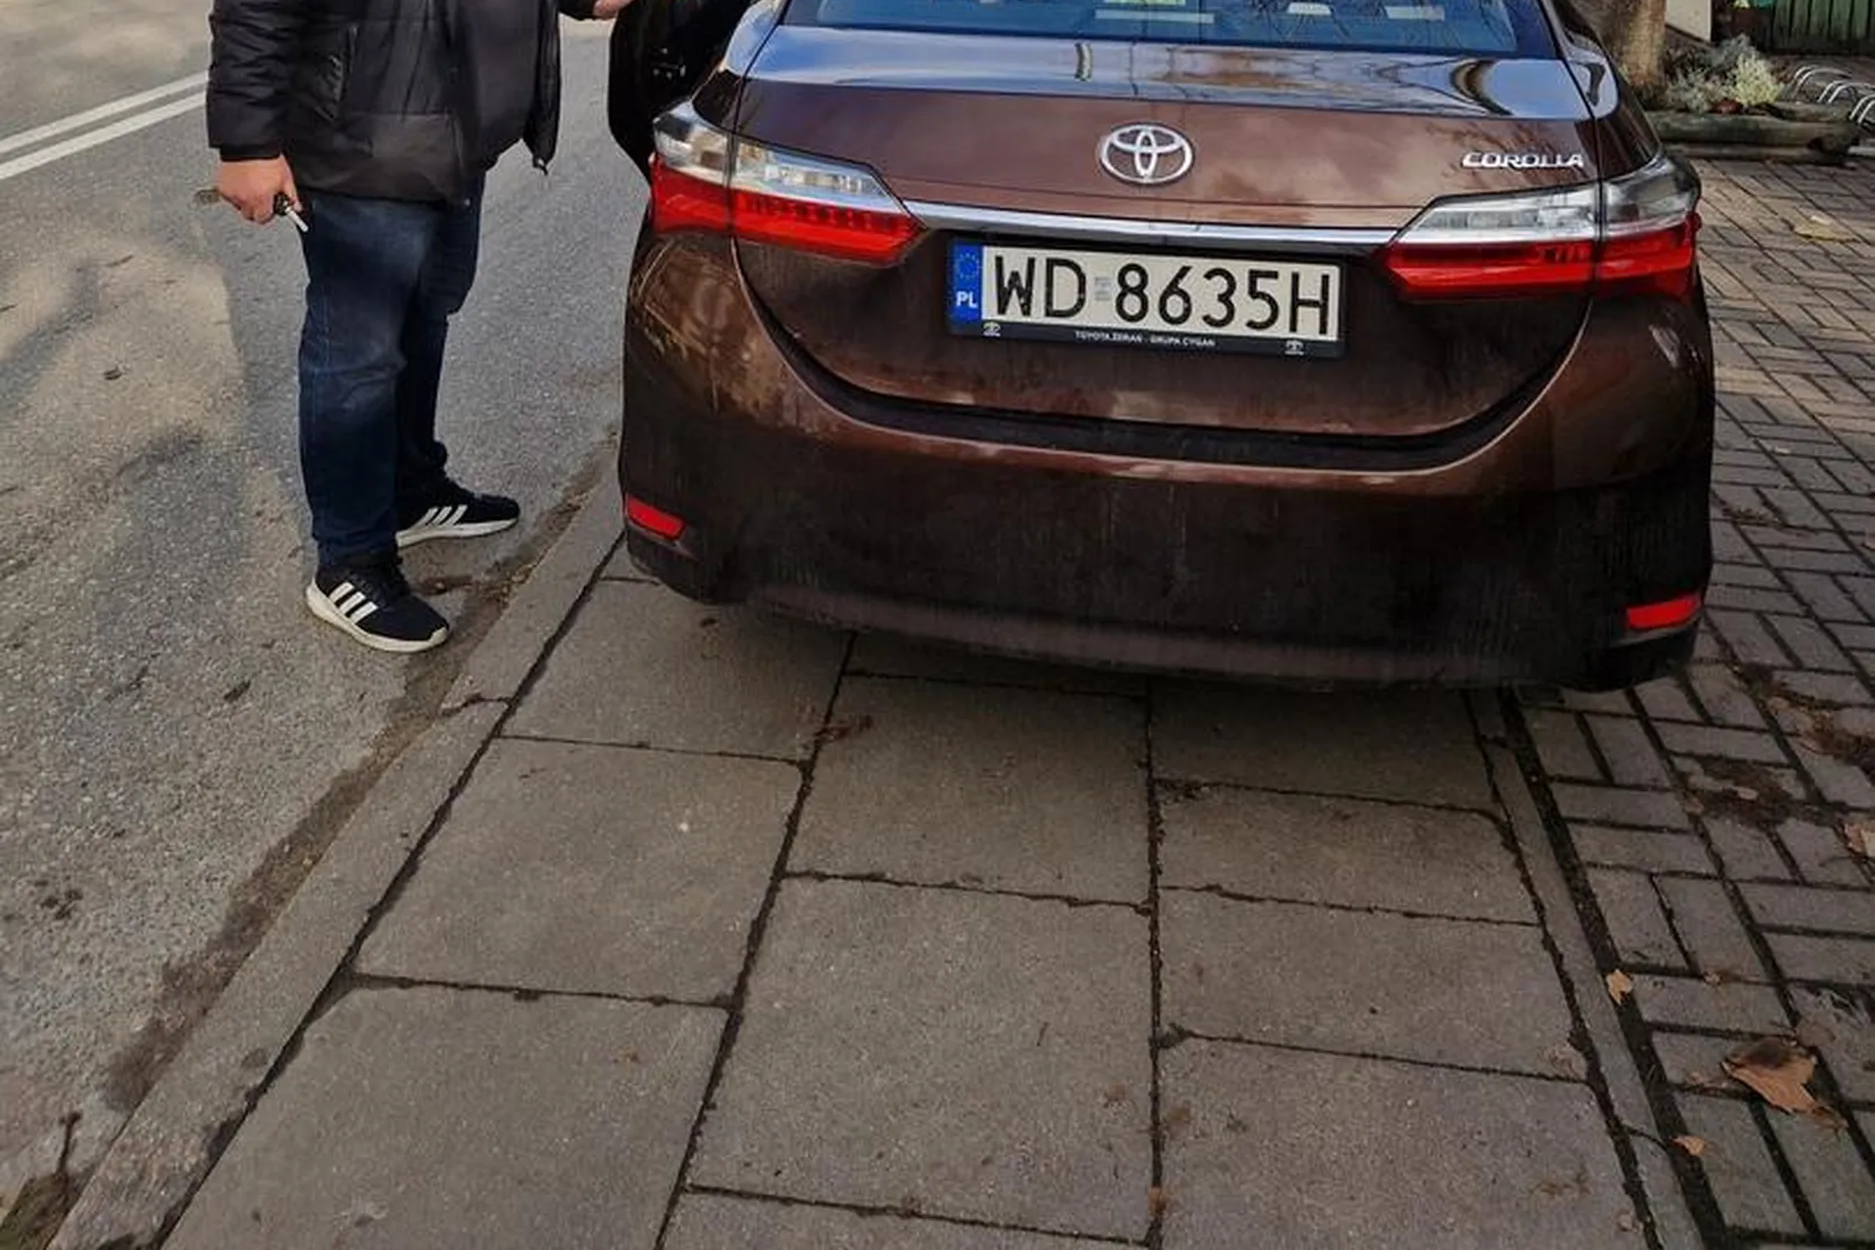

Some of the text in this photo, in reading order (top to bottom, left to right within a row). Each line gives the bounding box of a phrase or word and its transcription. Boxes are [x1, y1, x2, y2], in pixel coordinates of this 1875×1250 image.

[1462, 152, 1585, 169] COROLLA
[956, 291, 978, 309] PL
[995, 255, 1331, 337] WD 8635H
